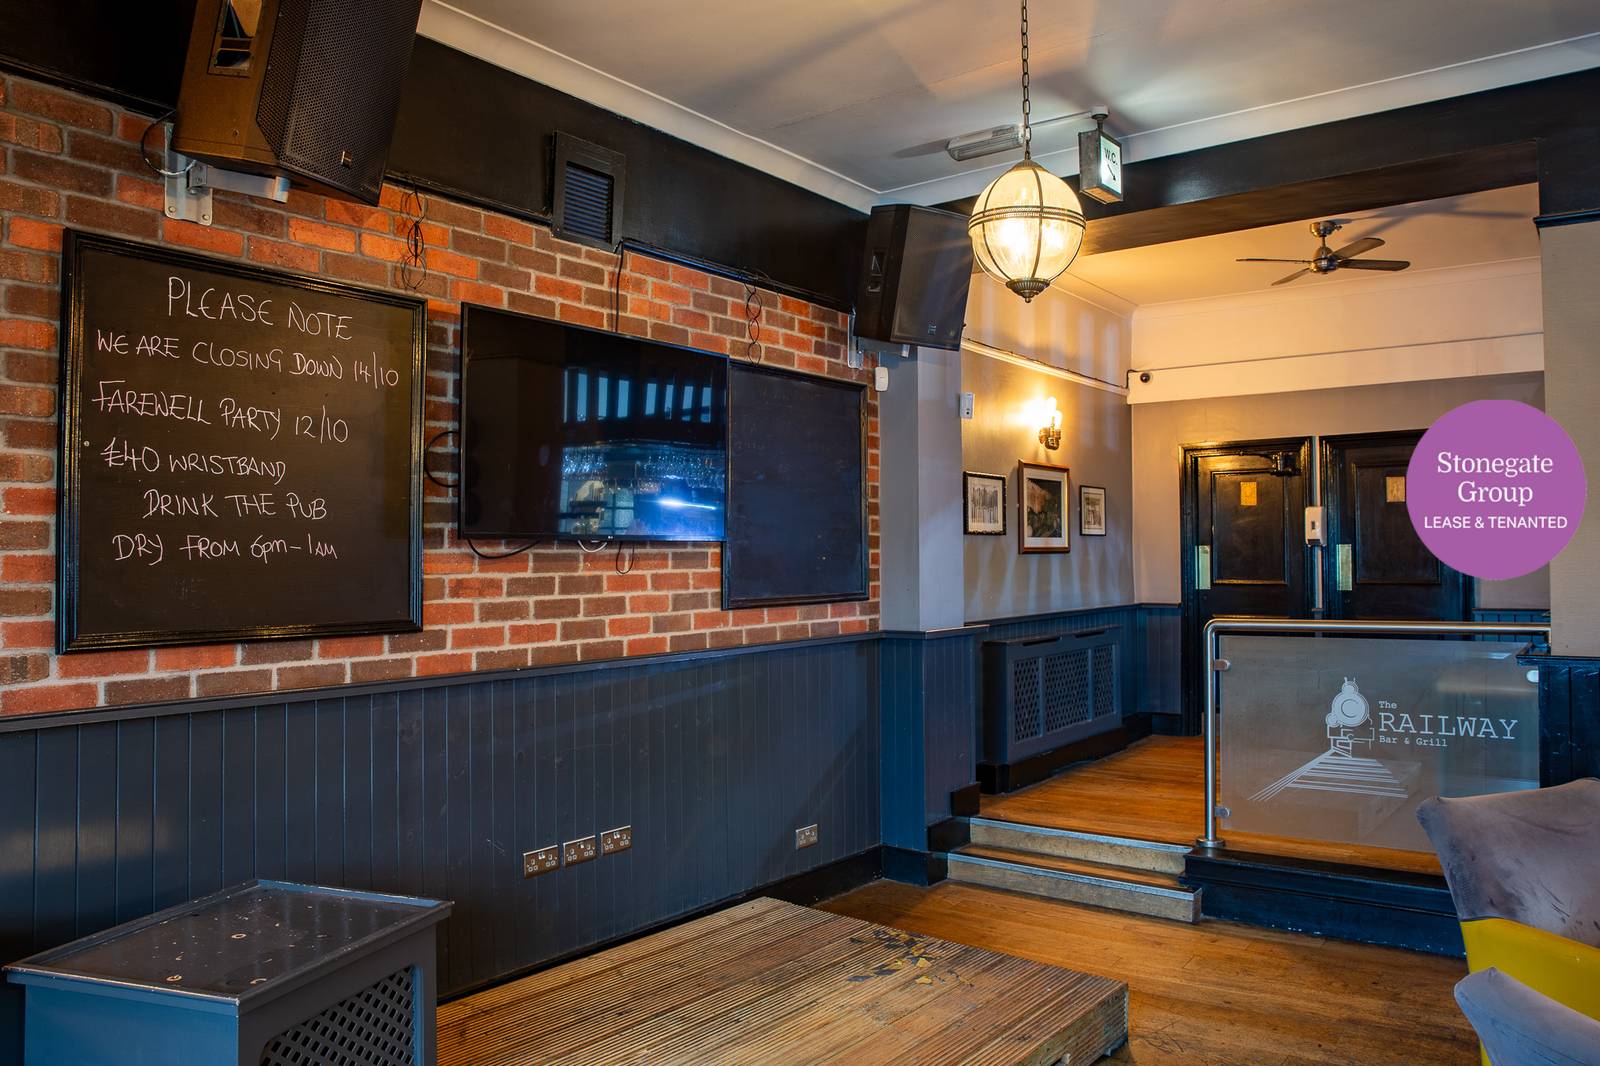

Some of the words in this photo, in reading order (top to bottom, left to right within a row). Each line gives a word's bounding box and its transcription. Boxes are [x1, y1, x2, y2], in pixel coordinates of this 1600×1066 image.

[167, 276, 274, 326] PLEASE
[288, 301, 353, 340] NOTE
[97, 330, 129, 355] WE
[135, 335, 180, 359] ARE
[192, 341, 283, 373] CLOSING
[289, 352, 343, 380] DOWN
[354, 351, 399, 389] 14/10
[92, 380, 212, 425] FAREWELL
[219, 397, 281, 441] PARTY
[295, 405, 348, 443] 12/10
[100, 436, 160, 472] £40
[169, 453, 287, 486] WRISTBAND
[142, 488, 219, 520] DRINK
[225, 492, 277, 517] THE
[286, 492, 328, 520] PUB
[112, 533, 164, 566] DRY
[179, 534, 241, 560] FROM
[1378, 700, 1398, 710] The
[1378, 712, 1518, 740] RAILWAY
[1379, 735, 1397, 744] Bar
[1403, 736, 1410, 745] &
[1416, 737, 1448, 747] Grill
